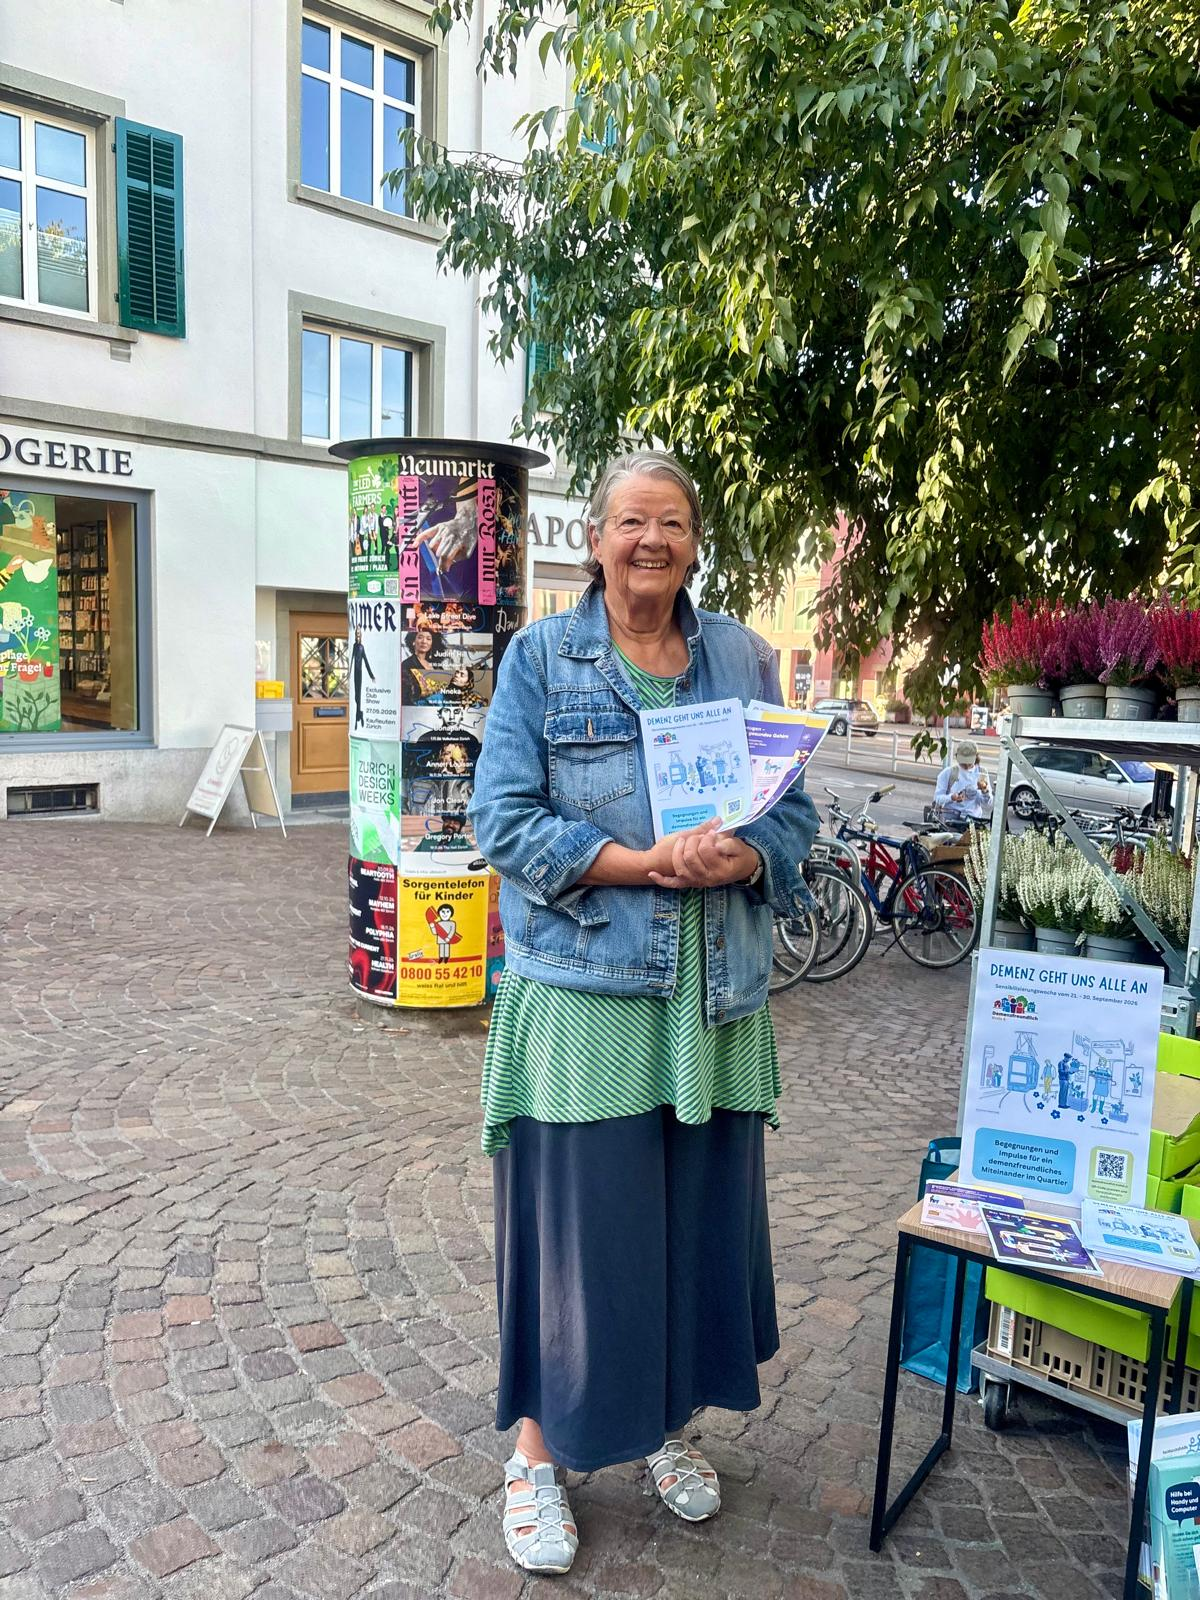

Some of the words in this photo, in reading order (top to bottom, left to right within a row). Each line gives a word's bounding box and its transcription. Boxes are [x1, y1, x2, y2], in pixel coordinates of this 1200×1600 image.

[400, 455, 496, 479] Neumarkt
[353, 493, 382, 508] FARMERS
[647, 715, 673, 726] DEMENZ
[673, 713, 689, 723] GEHT
[691, 711, 704, 720] UNS
[706, 708, 721, 718] ALLE
[722, 706, 732, 715] AN
[358, 760, 395, 776] ZURICH
[358, 775, 395, 791] DESIGN
[359, 791, 395, 806] WEEKS
[425, 834, 452, 842] Gregory
[403, 878, 485, 890] Sorgentelefon
[415, 891, 431, 900] für
[435, 891, 474, 900] Kinder
[369, 899, 395, 909] MAYHEM
[401, 966, 432, 980] 0800
[435, 967, 450, 980] 55
[453, 966, 468, 979] 42
[470, 964, 483, 977] 10
[990, 963, 1035, 982] DEMENZ
[1039, 969, 1068, 985] GEHT
[1071, 974, 1096, 988] UNS
[1099, 976, 1127, 992] ALLE
[1130, 980, 1148, 994] AN
[1092, 995, 1123, 1004] September
[994, 1139, 1044, 1154] Begegnungen
[1044, 1147, 1059, 1156] und
[998, 1150, 1031, 1162] Impulse
[1032, 1154, 1041, 1163] für
[1041, 1157, 1053, 1165] ein
[988, 1157, 1062, 1176] demenzfreundliches
[981, 1166, 1025, 1180] Miteinander
[1026, 1173, 1035, 1181] im
[1036, 1174, 1068, 1187] Quartier
[1170, 1498, 1188, 1506] Handy
[1171, 1505, 1198, 1514] Computer
